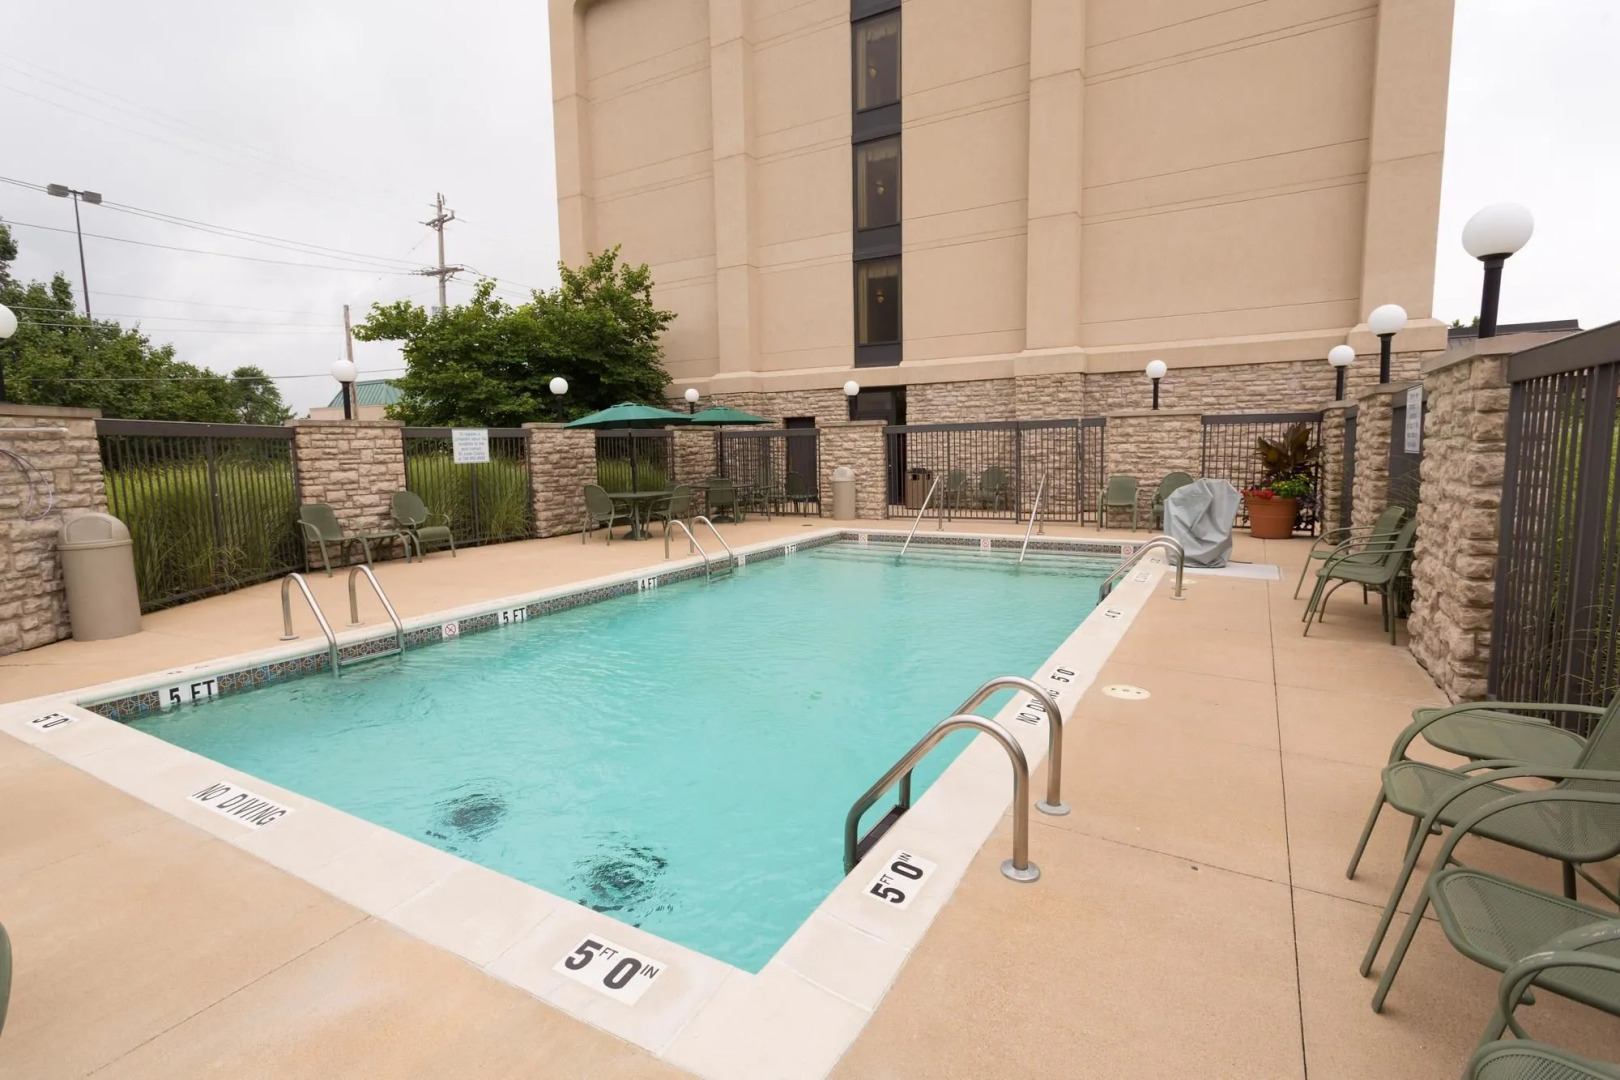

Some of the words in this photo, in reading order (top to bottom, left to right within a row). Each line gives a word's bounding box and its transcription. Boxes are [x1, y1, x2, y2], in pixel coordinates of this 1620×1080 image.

[641, 579, 646, 591] 4
[647, 576, 656, 590] FT
[502, 611, 509, 624] 5
[513, 607, 525, 623] FT
[1050, 675, 1070, 683] 5
[1056, 668, 1075, 676] 0
[169, 687, 181, 704] 5
[190, 679, 215, 699] FT
[32, 713, 59, 724] 5
[42, 718, 69, 728] 0
[1015, 712, 1041, 725] NO
[191, 783, 231, 801] NO
[216, 793, 287, 825] DIVING
[898, 852, 912, 862] IN
[891, 861, 924, 880] 0
[879, 873, 894, 885] FT
[870, 882, 906, 904] 5
[564, 939, 604, 970] 5
[598, 947, 619, 960] FT
[603, 957, 642, 989] 0
[640, 964, 660, 979] IN
